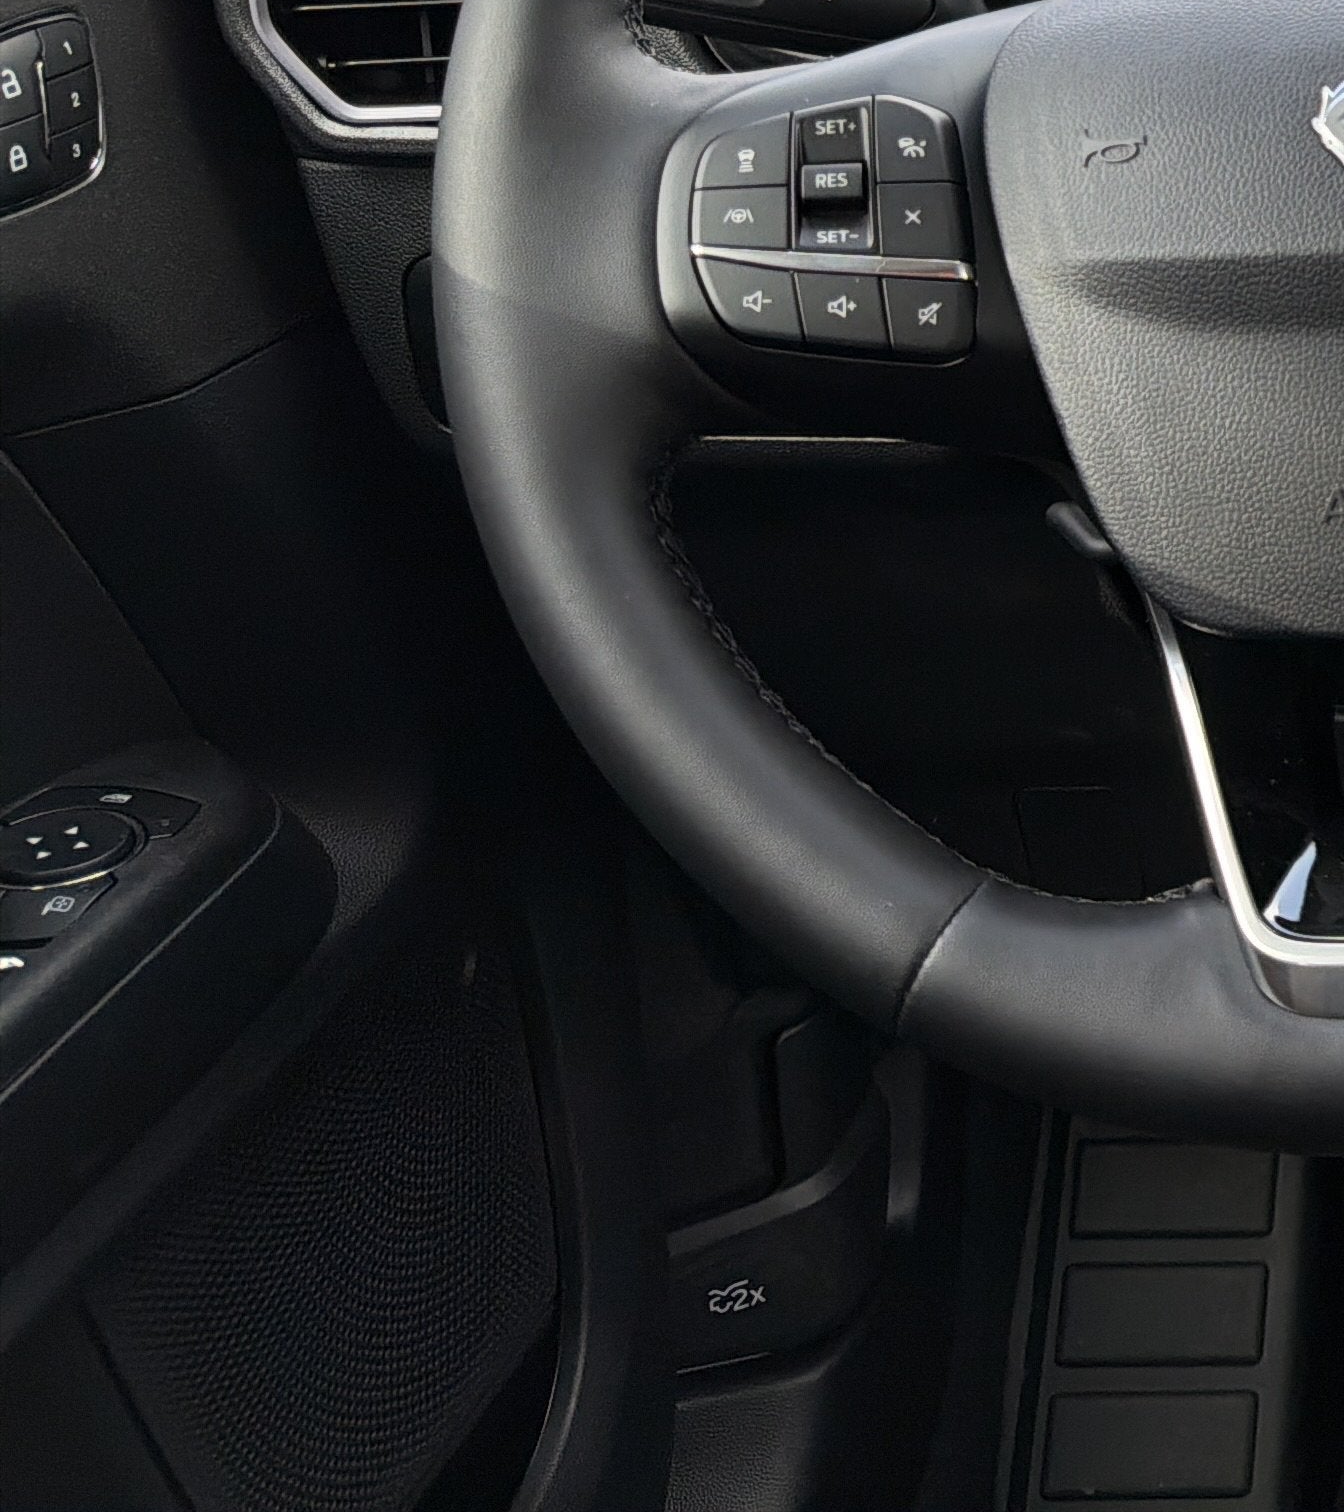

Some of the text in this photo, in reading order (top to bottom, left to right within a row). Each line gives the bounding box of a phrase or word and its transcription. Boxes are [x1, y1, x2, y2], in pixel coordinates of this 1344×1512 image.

[62, 40, 73, 56] 1
[70, 92, 81, 108] 2
[72, 143, 82, 158] 3
[814, 172, 848, 189] RES
